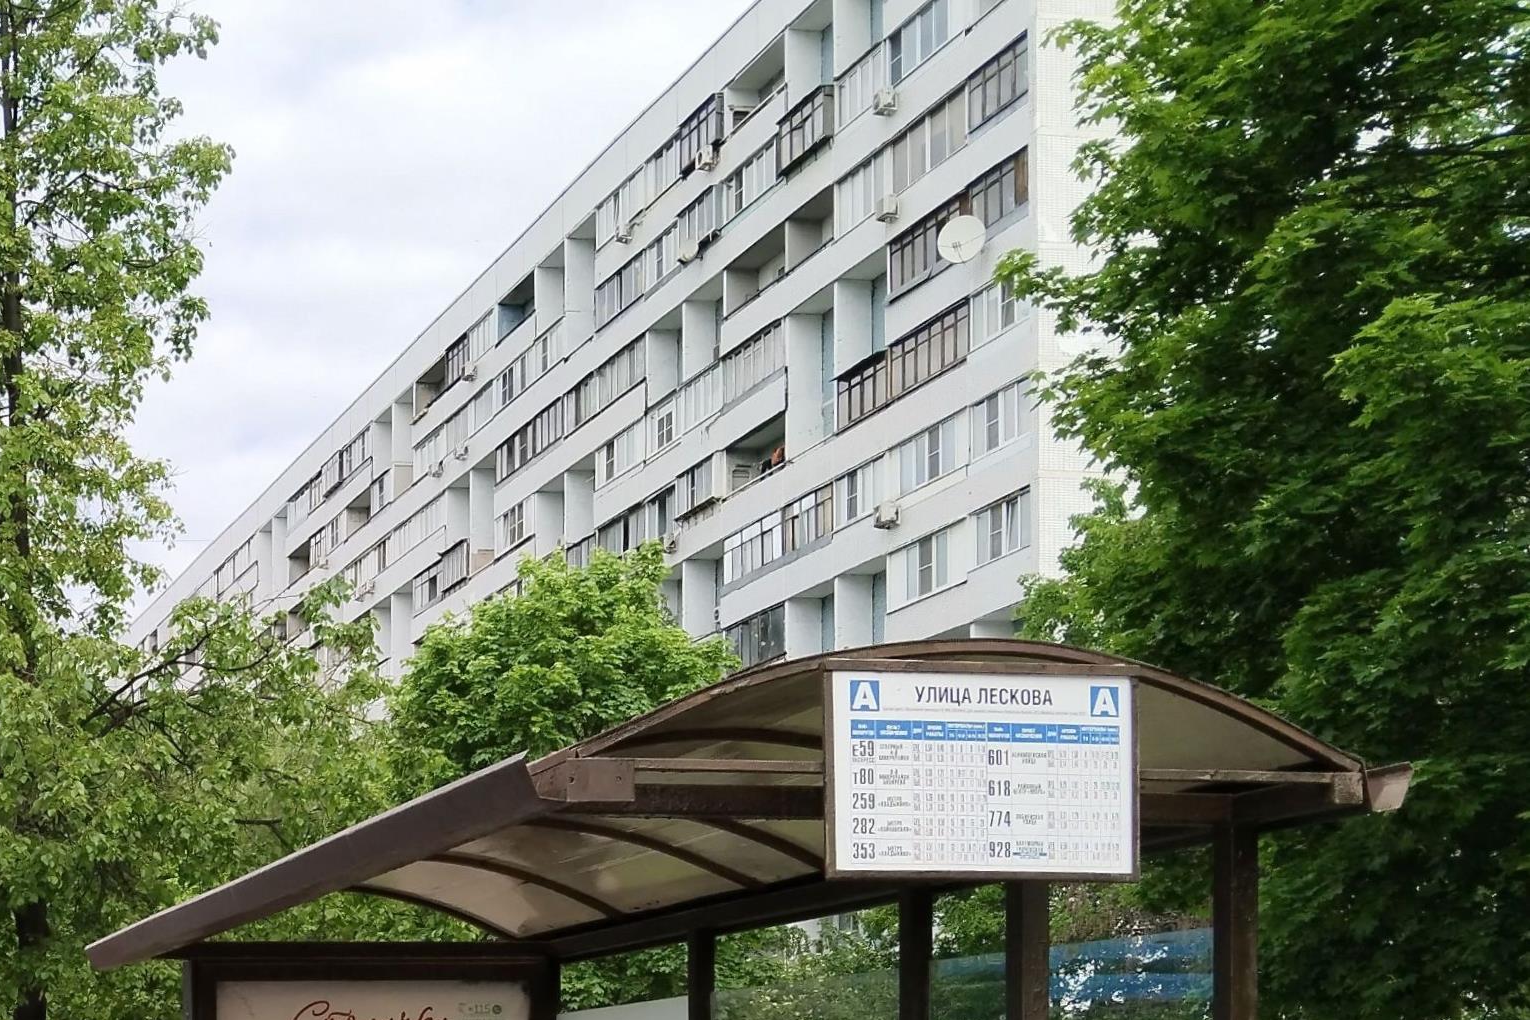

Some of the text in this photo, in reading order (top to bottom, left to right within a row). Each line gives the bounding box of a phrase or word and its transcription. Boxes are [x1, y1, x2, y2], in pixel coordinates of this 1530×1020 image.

[915, 686, 1053, 706] УЛИЦА ЛЕСКОВА
[988, 749, 1009, 766] 601
[988, 780, 1011, 797] 618
[852, 793, 875, 810] 259
[853, 817, 876, 834] 282
[989, 810, 1011, 827] 774
[853, 842, 875, 859] 353
[989, 841, 1011, 858] 928
